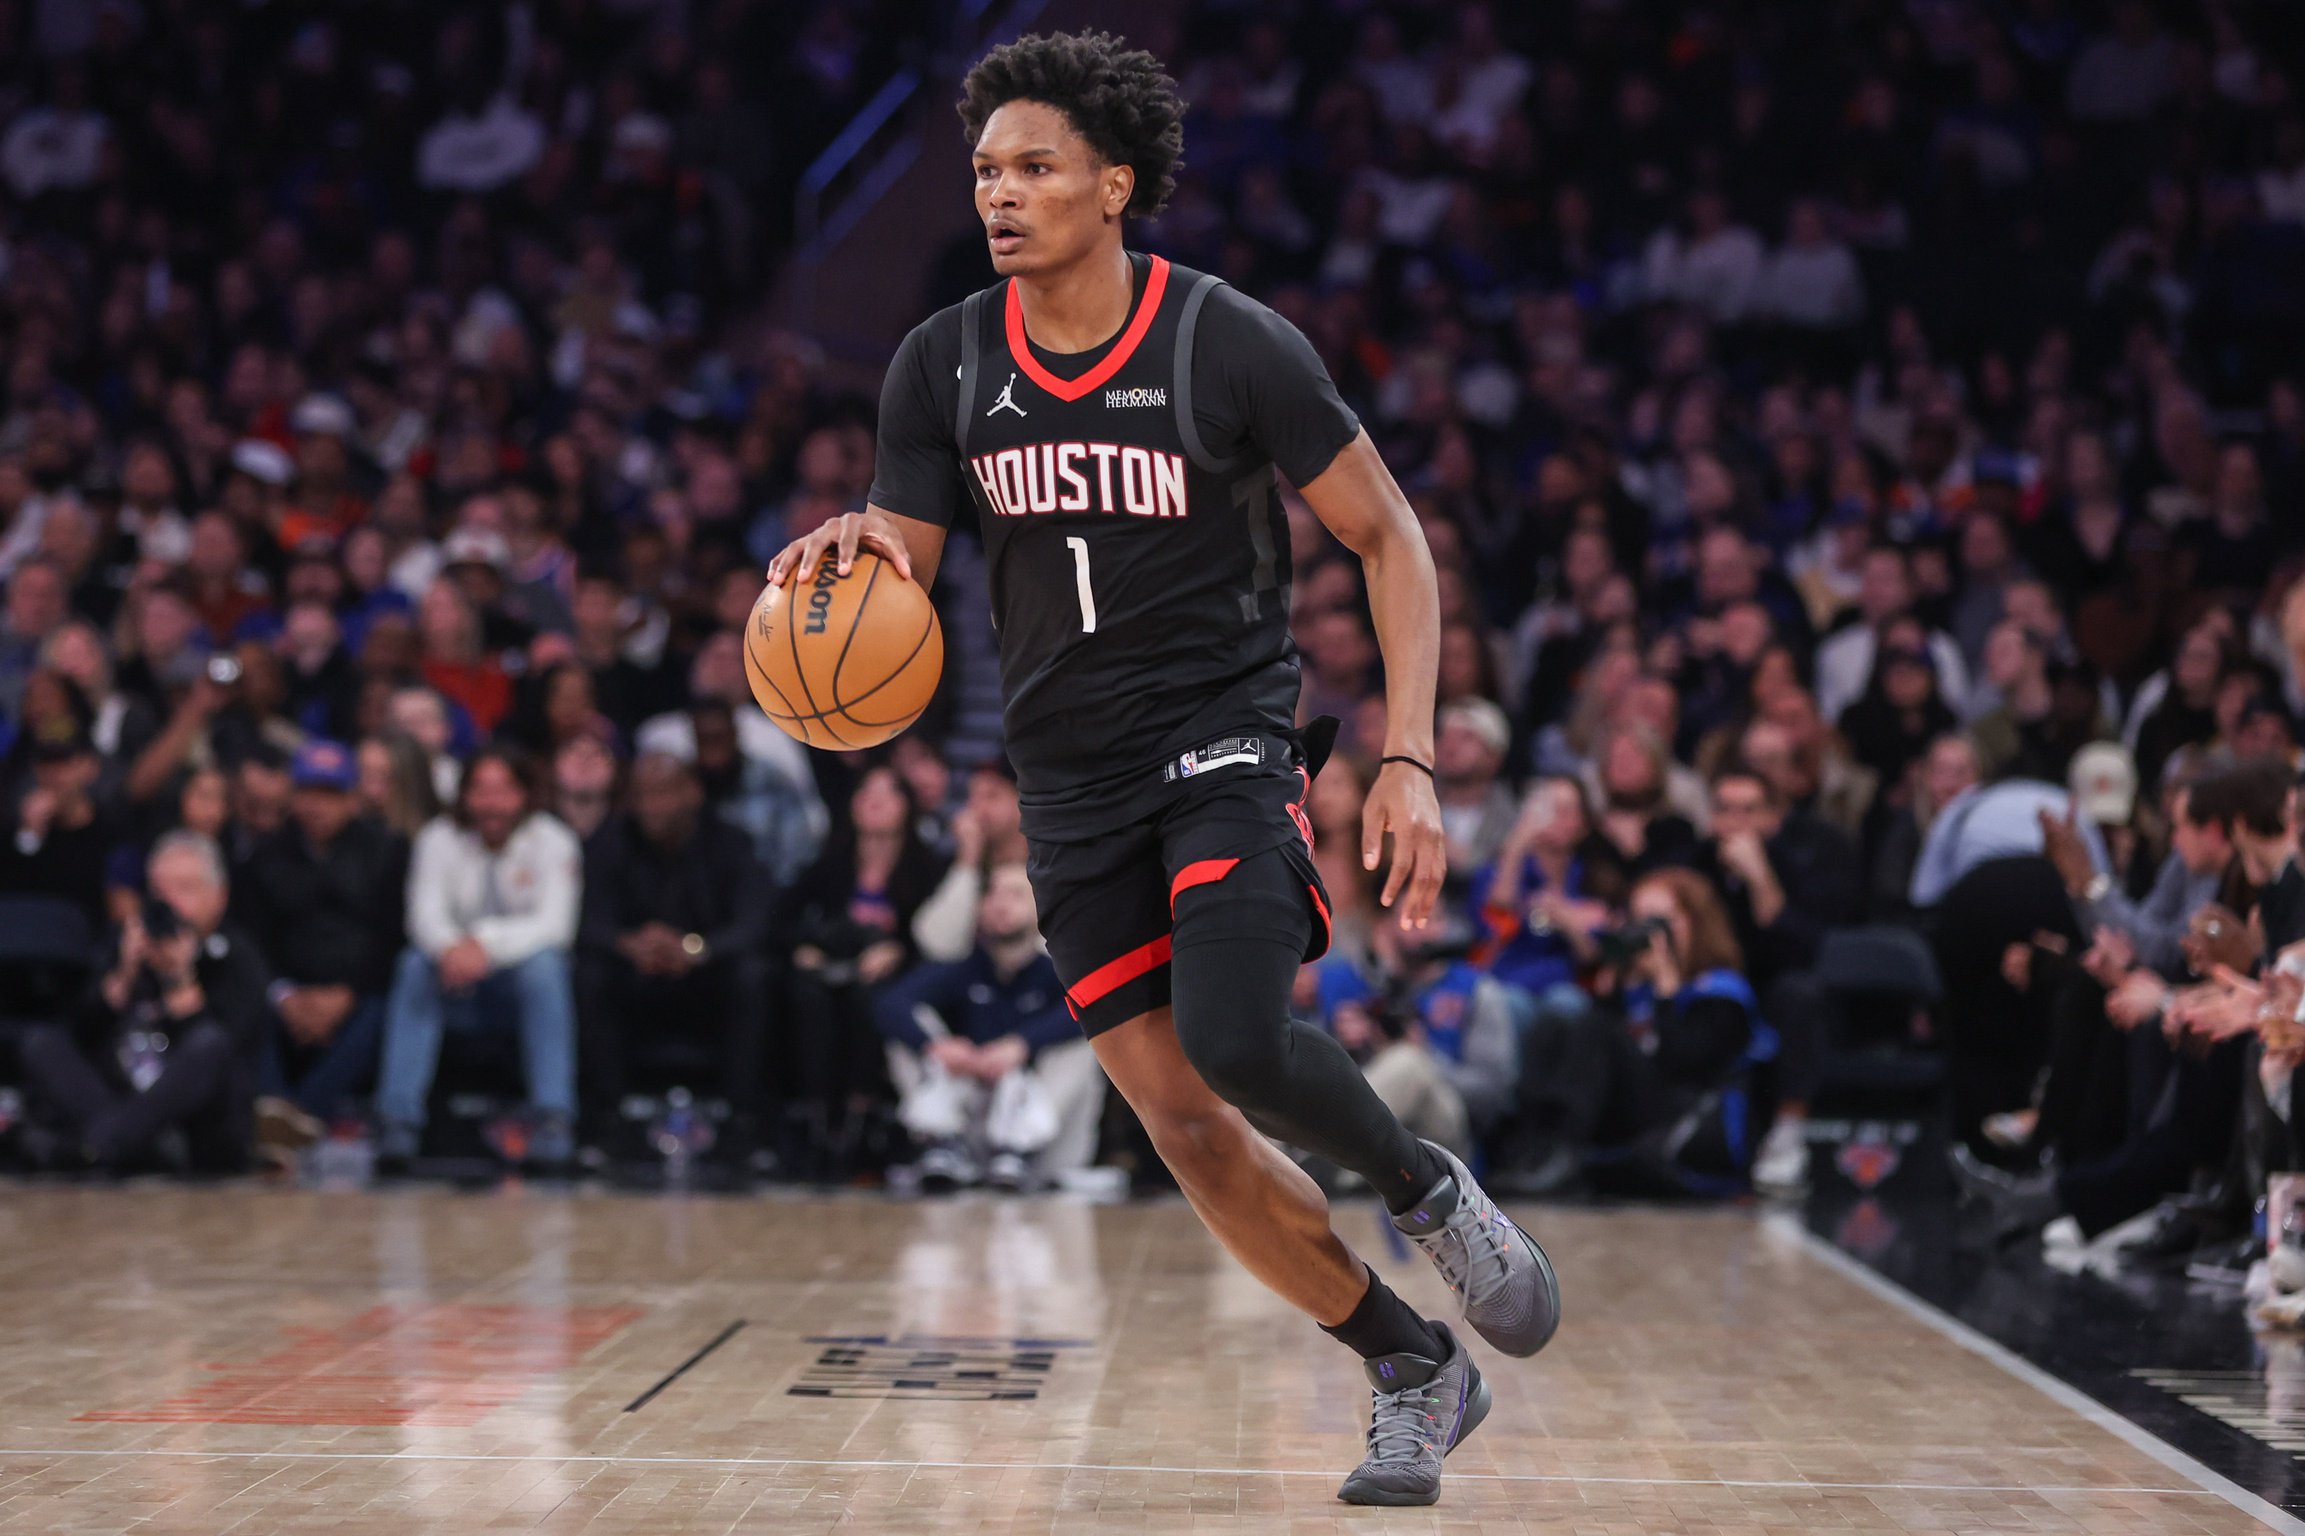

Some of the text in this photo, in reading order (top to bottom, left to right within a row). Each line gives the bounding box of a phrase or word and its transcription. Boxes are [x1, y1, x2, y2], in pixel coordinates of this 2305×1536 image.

[1106, 388, 1166, 400] MEMORIAL
[1106, 397, 1166, 408] HERMANN
[971, 442, 1188, 517] HOUSTON
[1066, 536, 1096, 633] 1
